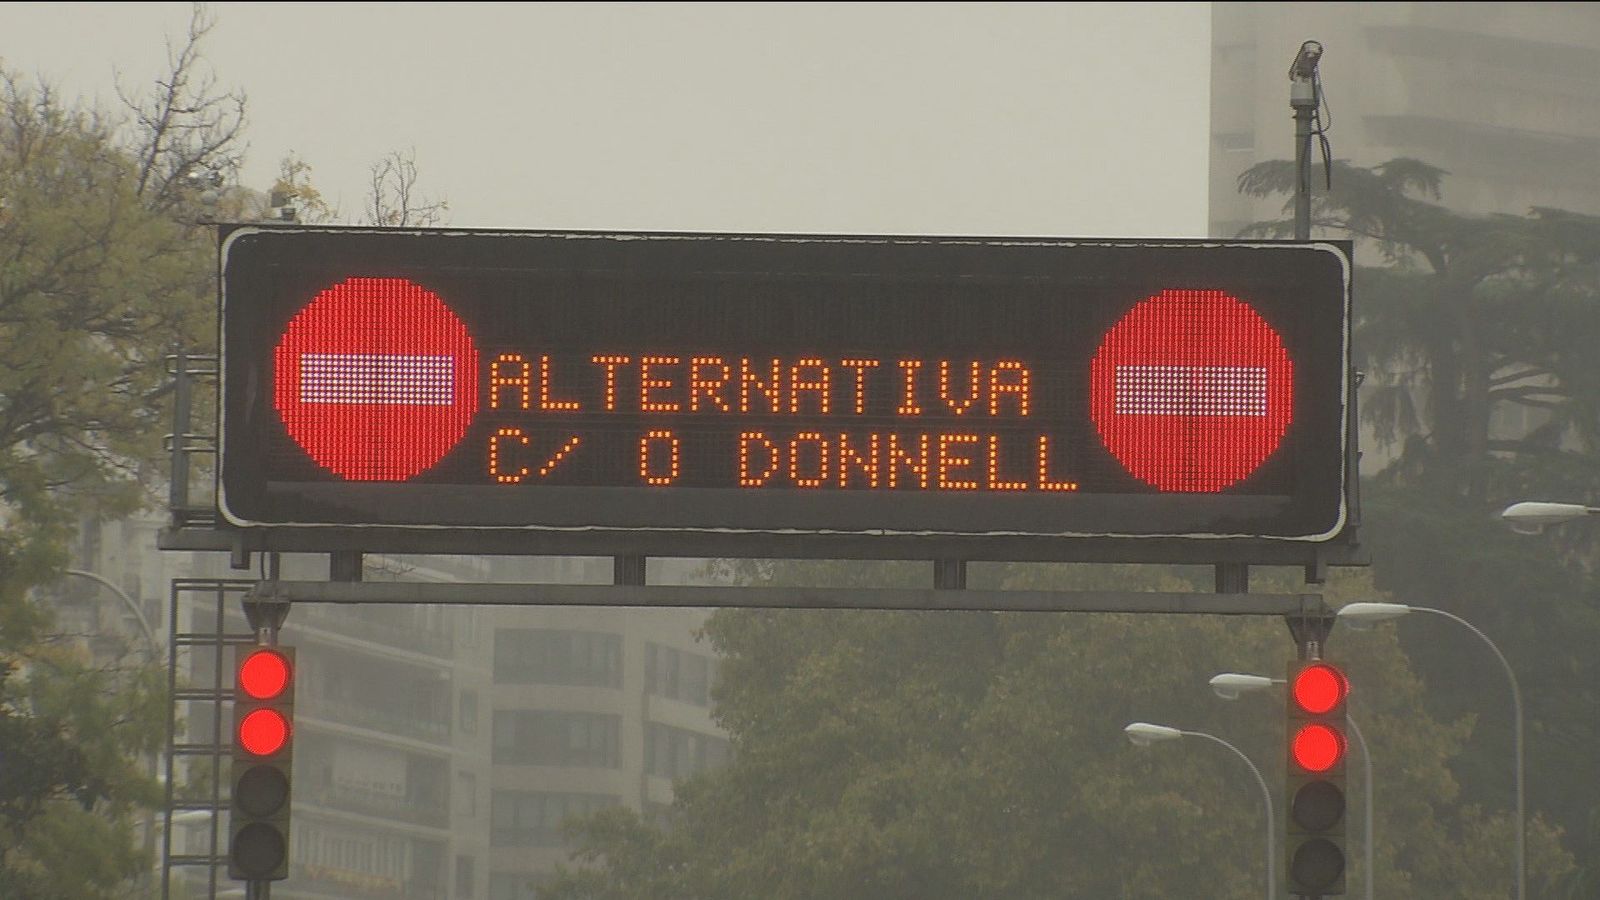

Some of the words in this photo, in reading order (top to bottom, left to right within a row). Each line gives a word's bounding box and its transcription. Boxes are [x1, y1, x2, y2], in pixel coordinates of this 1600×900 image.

[489, 354, 1031, 416] ALTERNATIVA
[489, 428, 579, 483] C/
[640, 430, 679, 485] O
[740, 431, 1077, 491] DONNELL
